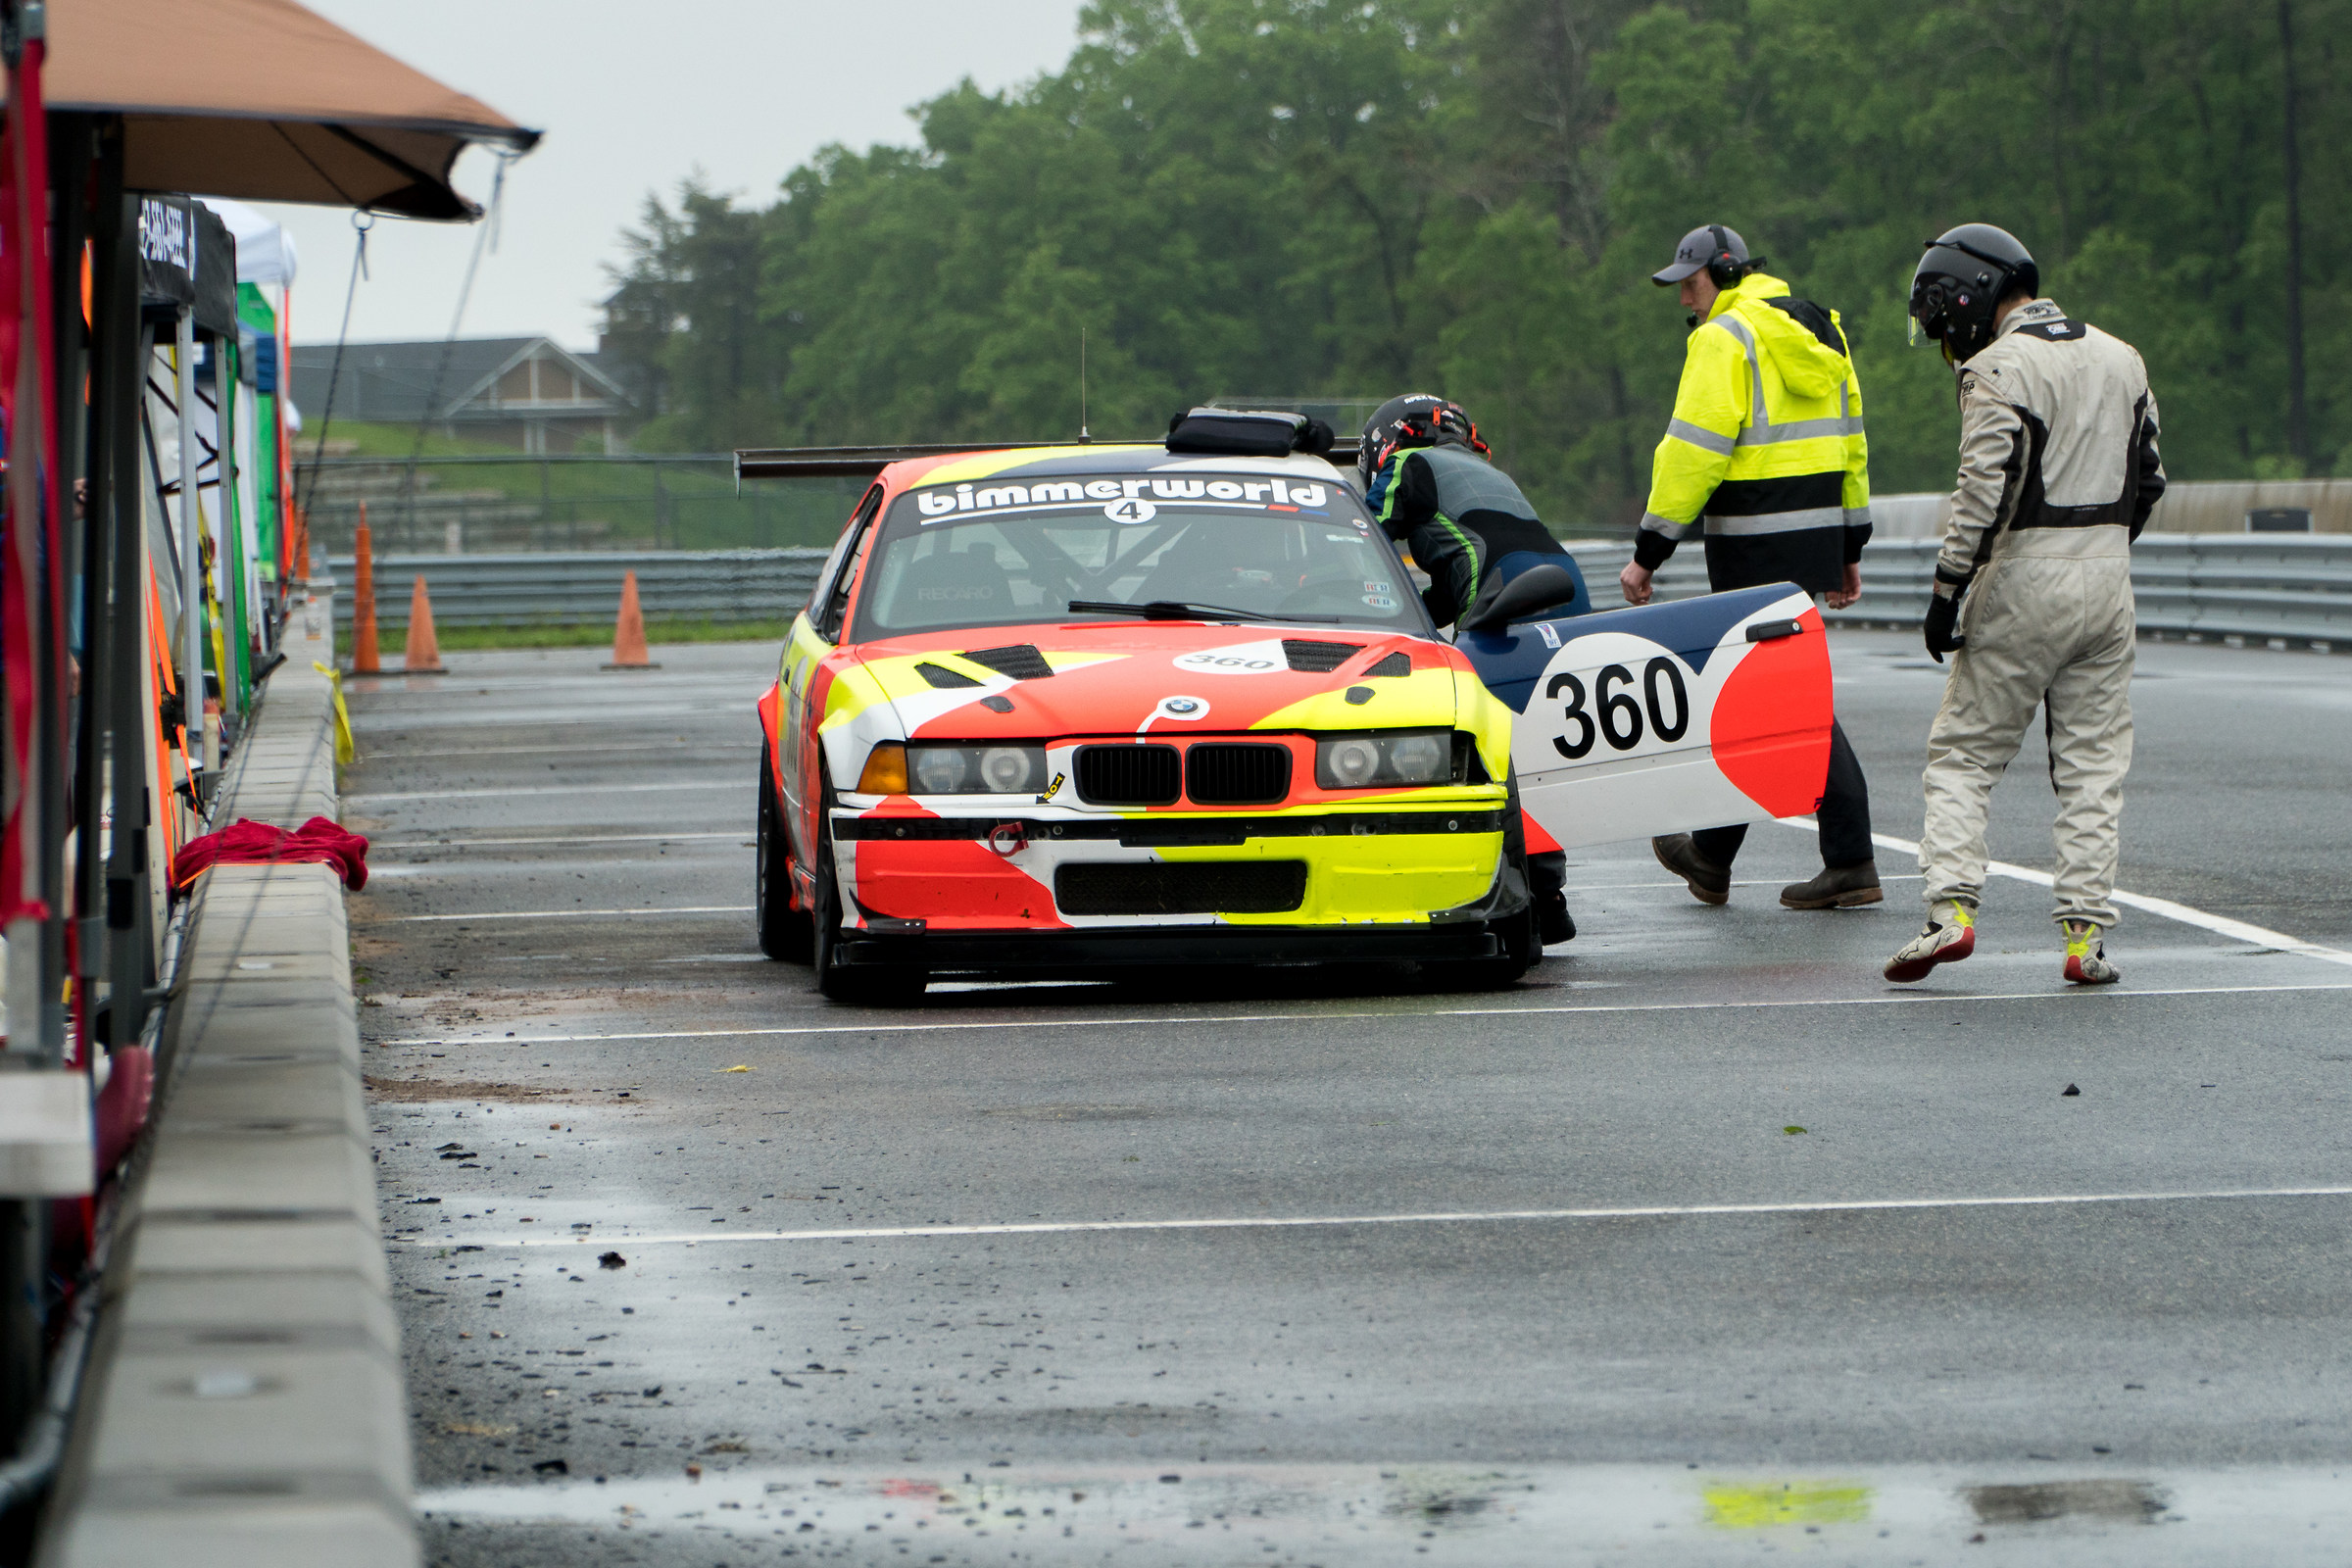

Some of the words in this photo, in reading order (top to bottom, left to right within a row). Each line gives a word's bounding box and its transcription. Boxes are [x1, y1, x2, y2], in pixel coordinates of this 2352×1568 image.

[917, 479, 1326, 516] bimmerworld
[1115, 501, 1142, 520] 4
[1184, 655, 1275, 669] 360
[1545, 656, 1690, 760] 360
[1042, 775, 1063, 800] TOW
